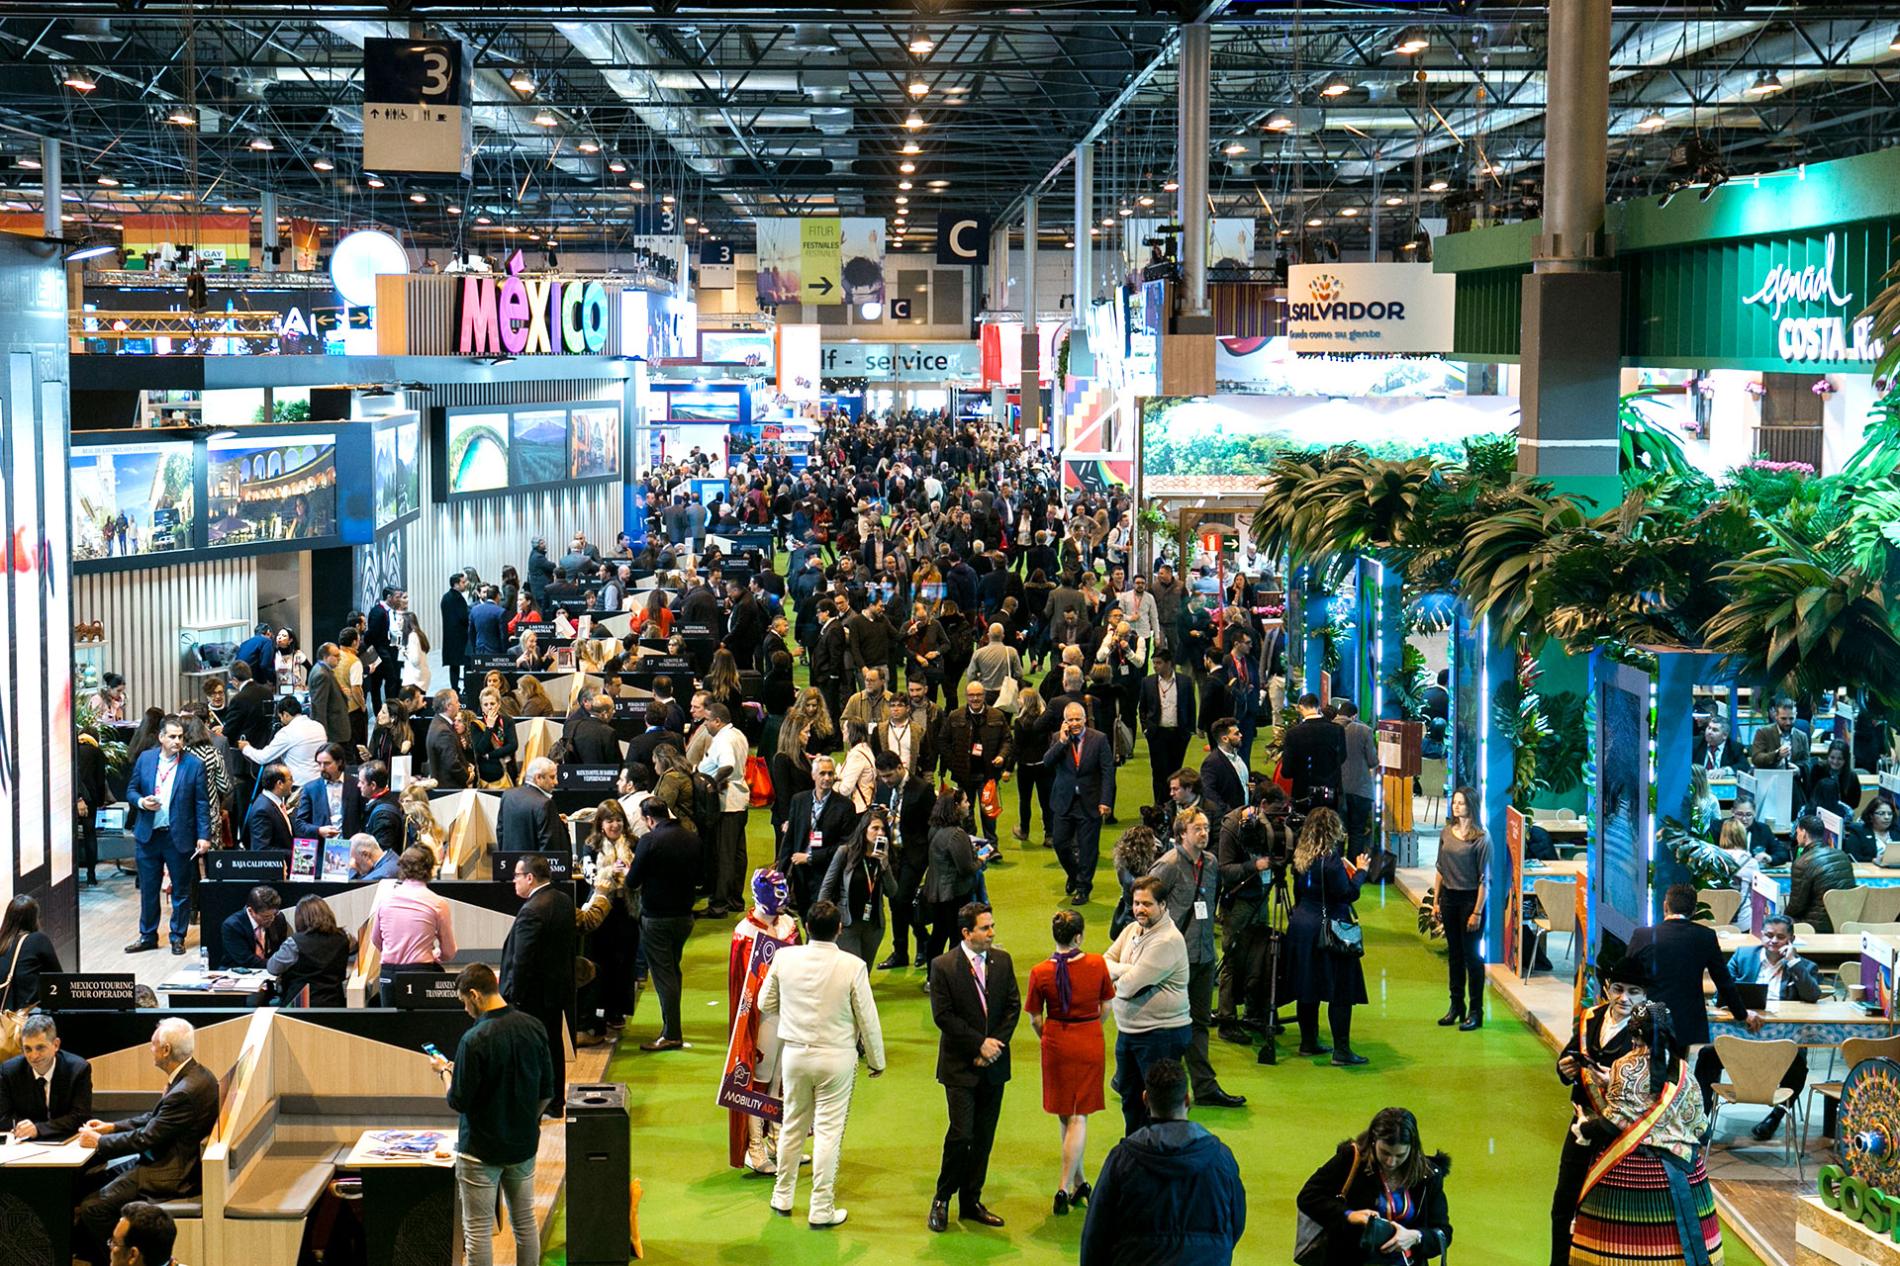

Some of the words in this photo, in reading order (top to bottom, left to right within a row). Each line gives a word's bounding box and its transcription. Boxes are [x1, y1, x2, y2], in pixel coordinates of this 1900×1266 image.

[421, 52, 449, 96] 3
[661, 211, 675, 231] 3
[808, 225, 834, 237] FITUR
[949, 219, 978, 258] C
[802, 241, 840, 249] FESTIVALES
[203, 250, 223, 258] GAY
[719, 246, 731, 262] 3
[894, 301, 908, 317] C
[1308, 331, 1332, 339] como
[1334, 331, 1347, 339] su
[1349, 329, 1382, 342] gente
[1778, 316, 1848, 361] COSTA
[865, 350, 948, 371] service
[562, 772, 569, 780] 9
[215, 859, 223, 869] 6
[232, 860, 247, 869] BAJA
[247, 860, 283, 868] CALIFORNIA
[500, 860, 507, 870] 5
[49, 984, 58, 995] 2
[69, 981, 99, 990] MEXICO
[100, 981, 134, 990] TOURING
[406, 984, 413, 995] 1
[71, 990, 91, 999] TOUR
[92, 990, 133, 999] OPERADOR
[724, 1091, 763, 1111] MOBILITY
